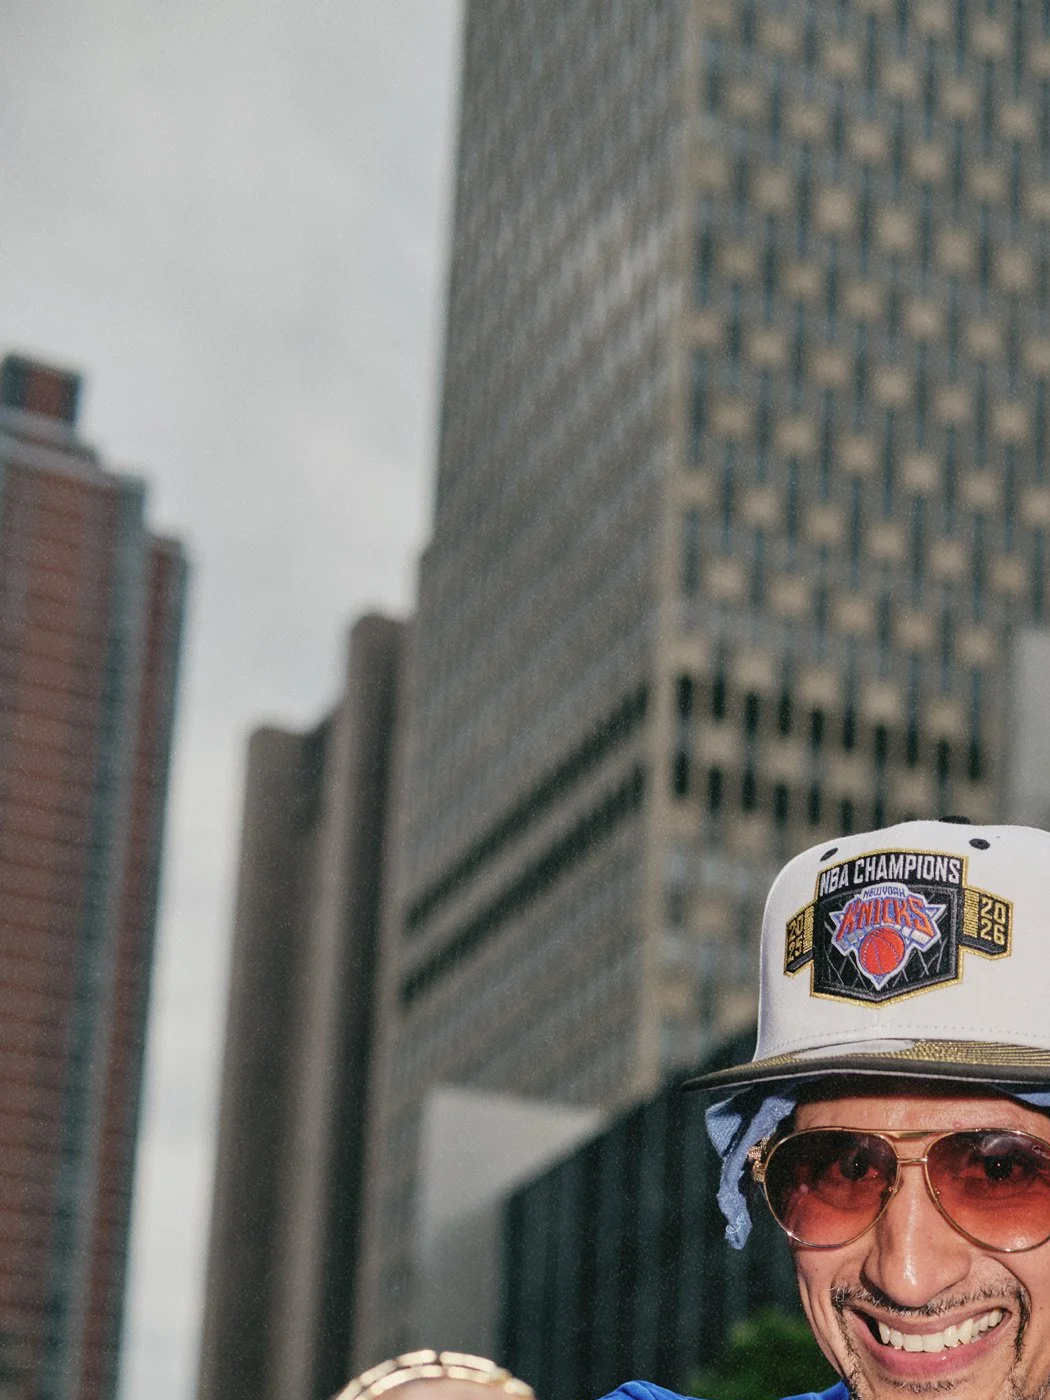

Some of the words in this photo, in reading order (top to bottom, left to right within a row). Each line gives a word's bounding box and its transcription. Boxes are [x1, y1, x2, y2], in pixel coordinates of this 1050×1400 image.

[819, 864, 849, 897] NBA
[853, 854, 961, 884] CHAMPIONS
[863, 886, 880, 899] NEW
[882, 886, 906, 899] YORK
[836, 895, 935, 941] KNICKS
[981, 897, 1006, 925] 20
[788, 913, 804, 942] 20
[980, 918, 1005, 946] 26
[788, 934, 804, 963] 25
